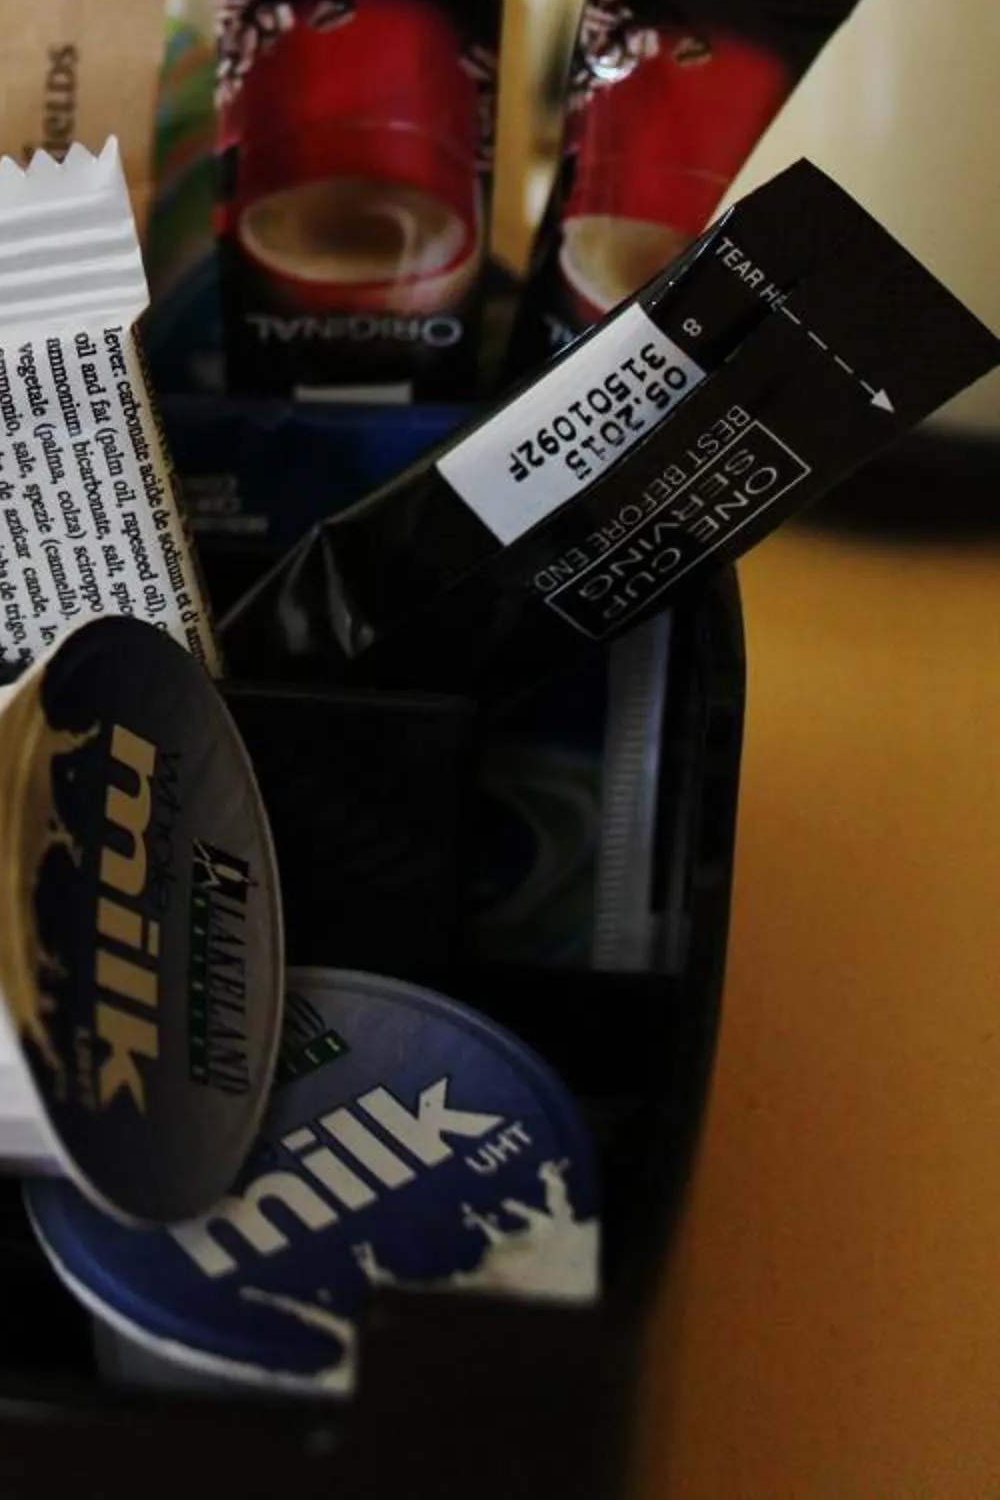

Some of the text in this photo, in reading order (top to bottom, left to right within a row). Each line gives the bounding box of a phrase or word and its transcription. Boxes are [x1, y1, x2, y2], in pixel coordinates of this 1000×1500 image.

[716, 237, 765, 289] TEAR
[74, 332, 97, 359] oil
[682, 317, 703, 337] 8
[81, 363, 107, 396] and
[90, 400, 112, 424] fat
[117, 381, 151, 462] carbonate
[508, 343, 666, 483] 31501092F
[565, 366, 687, 480] 05.2015
[688, 404, 750, 467] BEST
[12, 441, 37, 479] sale,
[16, 342, 104, 612] vegetale (palma, colza) sciroppo
[46, 337, 136, 615] ammonium bicarbonate, salt, spic
[95, 427, 124, 476] (palm
[22, 483, 55, 534] spezie
[113, 480, 136, 508] oil,
[140, 464, 166, 509] acide
[586, 464, 687, 551] BEFORE
[121, 511, 159, 581] rapeseed
[152, 509, 171, 531] de
[578, 448, 755, 600] SERVING
[603, 466, 778, 620] ONE CUP
[5, 508, 31, 559] azúcar
[22, 567, 48, 619] cande,
[39, 538, 82, 621] (cannella).
[158, 532, 185, 592] sodium
[0, 581, 17, 601] de
[143, 585, 168, 618] oil),
[175, 592, 192, 610] et
[5, 603, 28, 645] trigo,
[94, 723, 160, 1115] milk
[209, 901, 250, 1095] LAKELAND
[464, 1121, 533, 1174] UHT
[166, 1076, 504, 1278] milk
